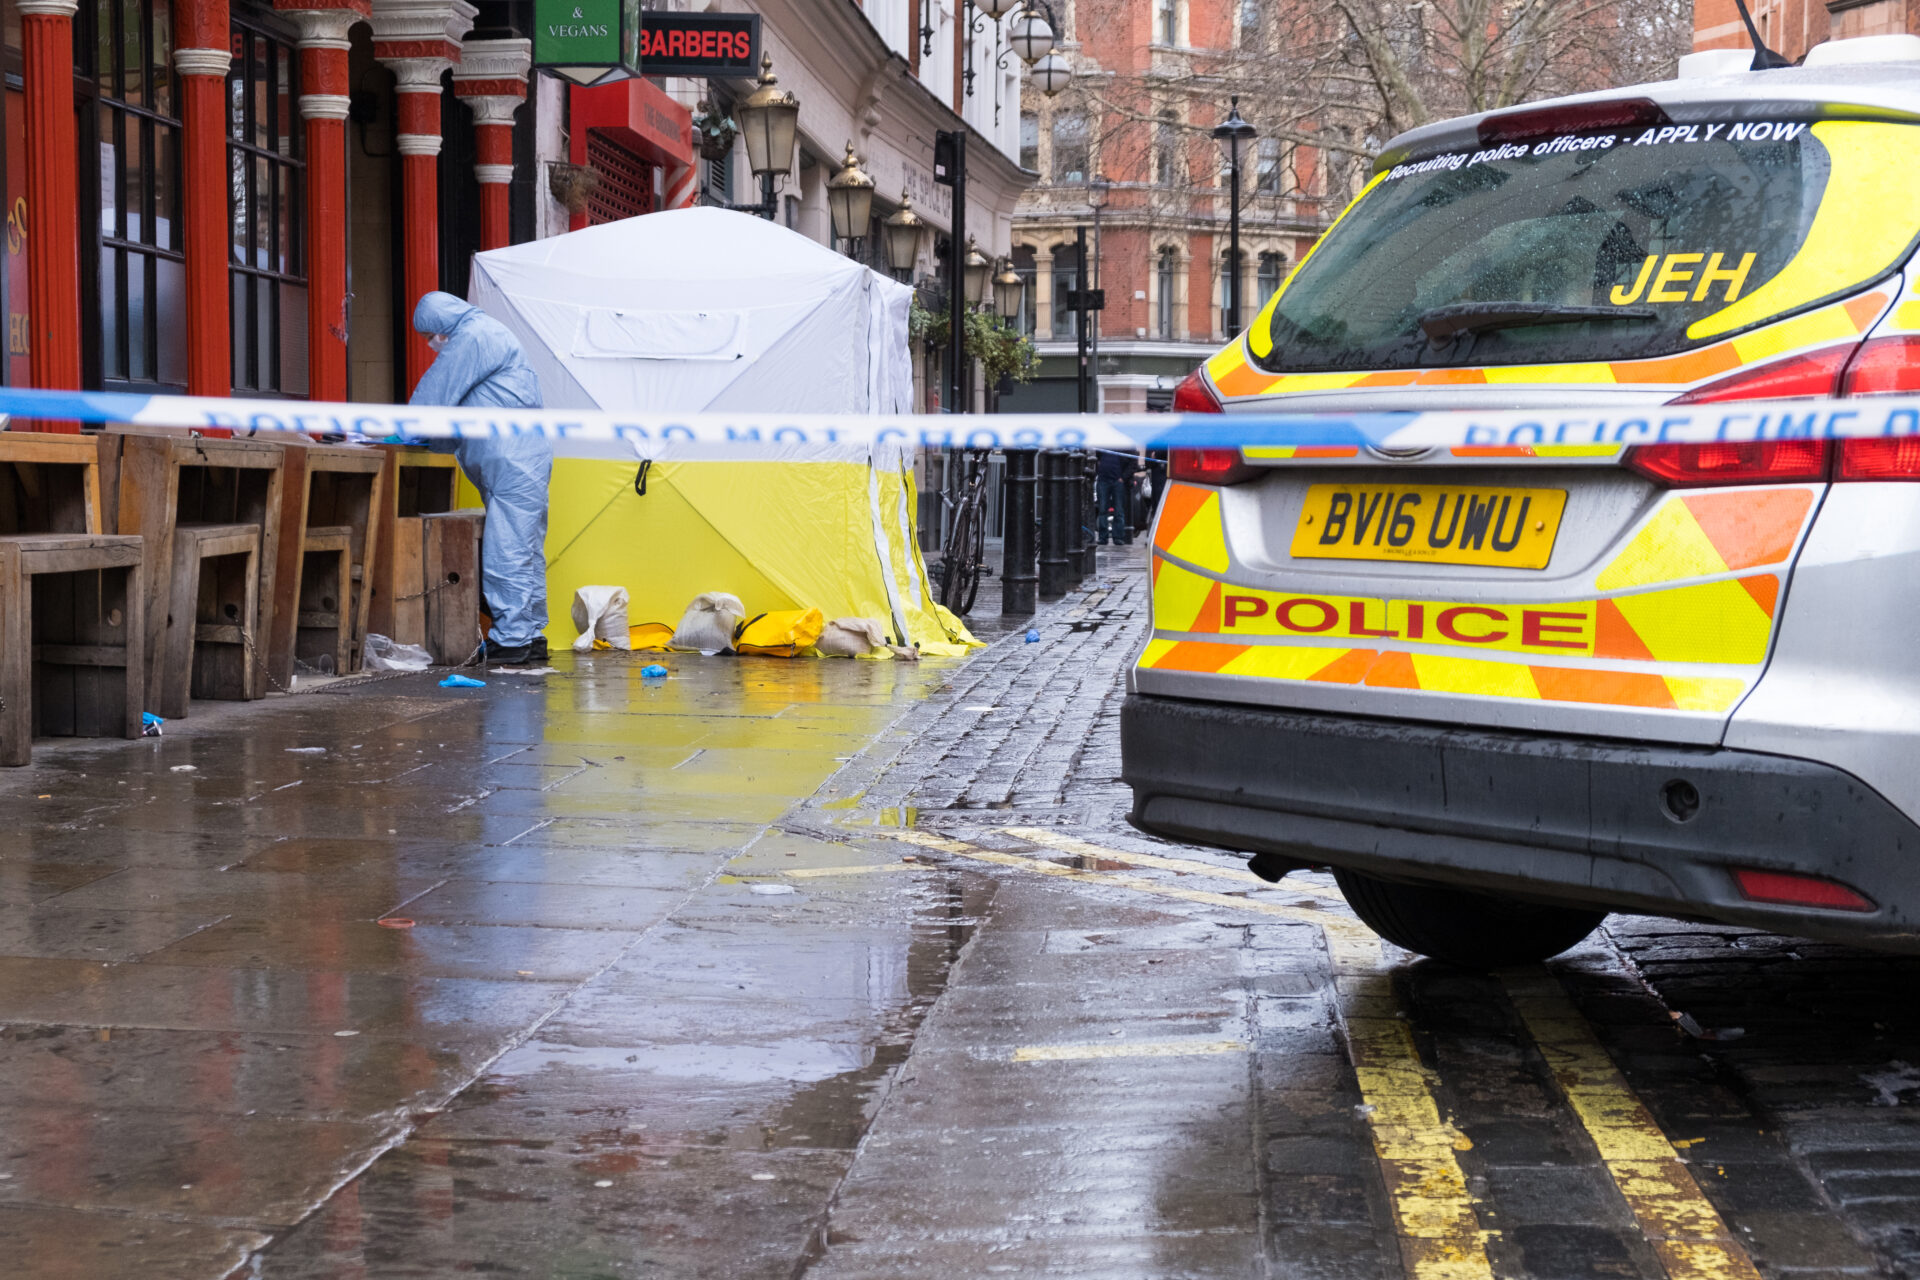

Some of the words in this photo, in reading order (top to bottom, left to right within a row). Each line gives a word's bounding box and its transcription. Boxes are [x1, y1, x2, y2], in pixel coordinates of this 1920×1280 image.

[548, 24, 608, 37] VEGANS
[571, 6, 584, 19] &
[640, 30, 750, 59] BARBERS
[1384, 151, 1468, 182] Recruiting
[1468, 142, 1531, 168] police
[1533, 133, 1617, 157] officers
[1633, 122, 1726, 147] APPLY
[1726, 121, 1808, 142] NOW
[1609, 252, 1757, 306] JEH
[1318, 492, 1422, 547] BV16
[1428, 493, 1532, 553] UWU
[1224, 595, 1589, 649] POLICE
